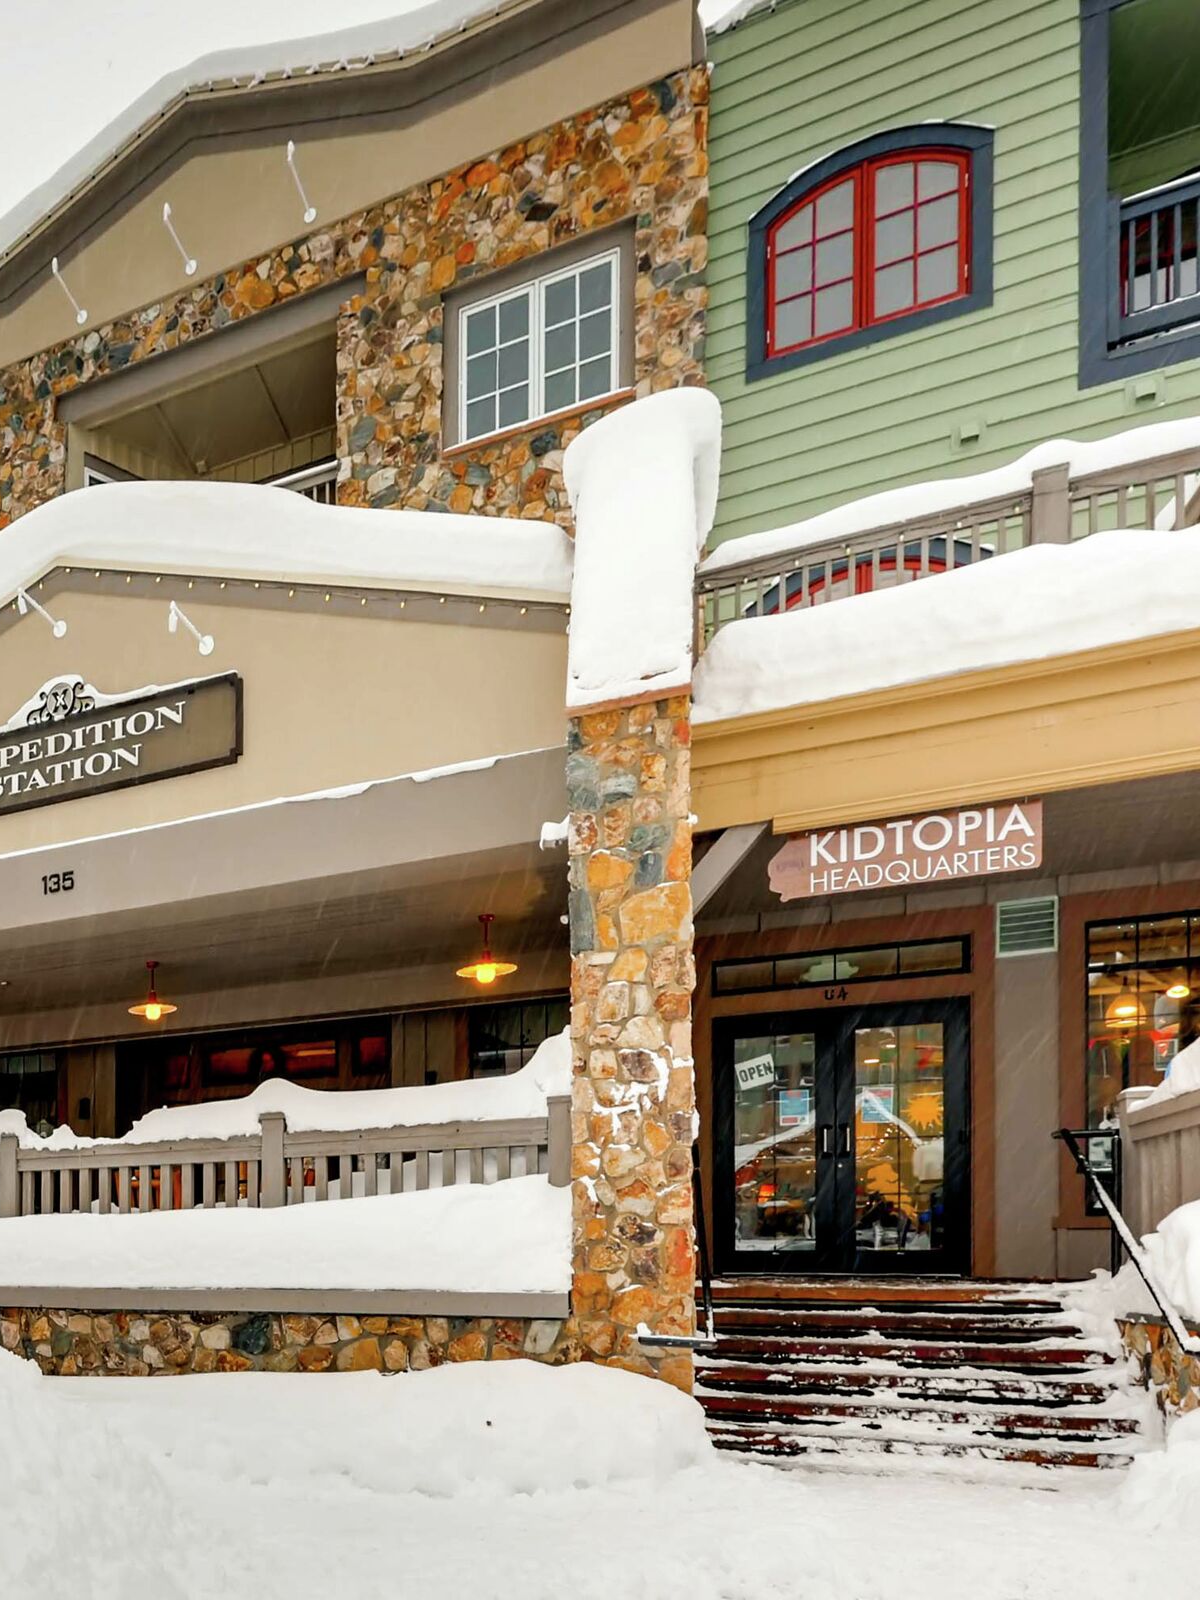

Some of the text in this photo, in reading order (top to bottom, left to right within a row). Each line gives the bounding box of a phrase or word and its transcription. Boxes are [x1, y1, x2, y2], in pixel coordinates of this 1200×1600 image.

[809, 803, 1036, 867] KIDTOPIA
[41, 870, 74, 895] 135
[810, 843, 1036, 893] HEADQUARTERS
[739, 1061, 773, 1083] OPEN
